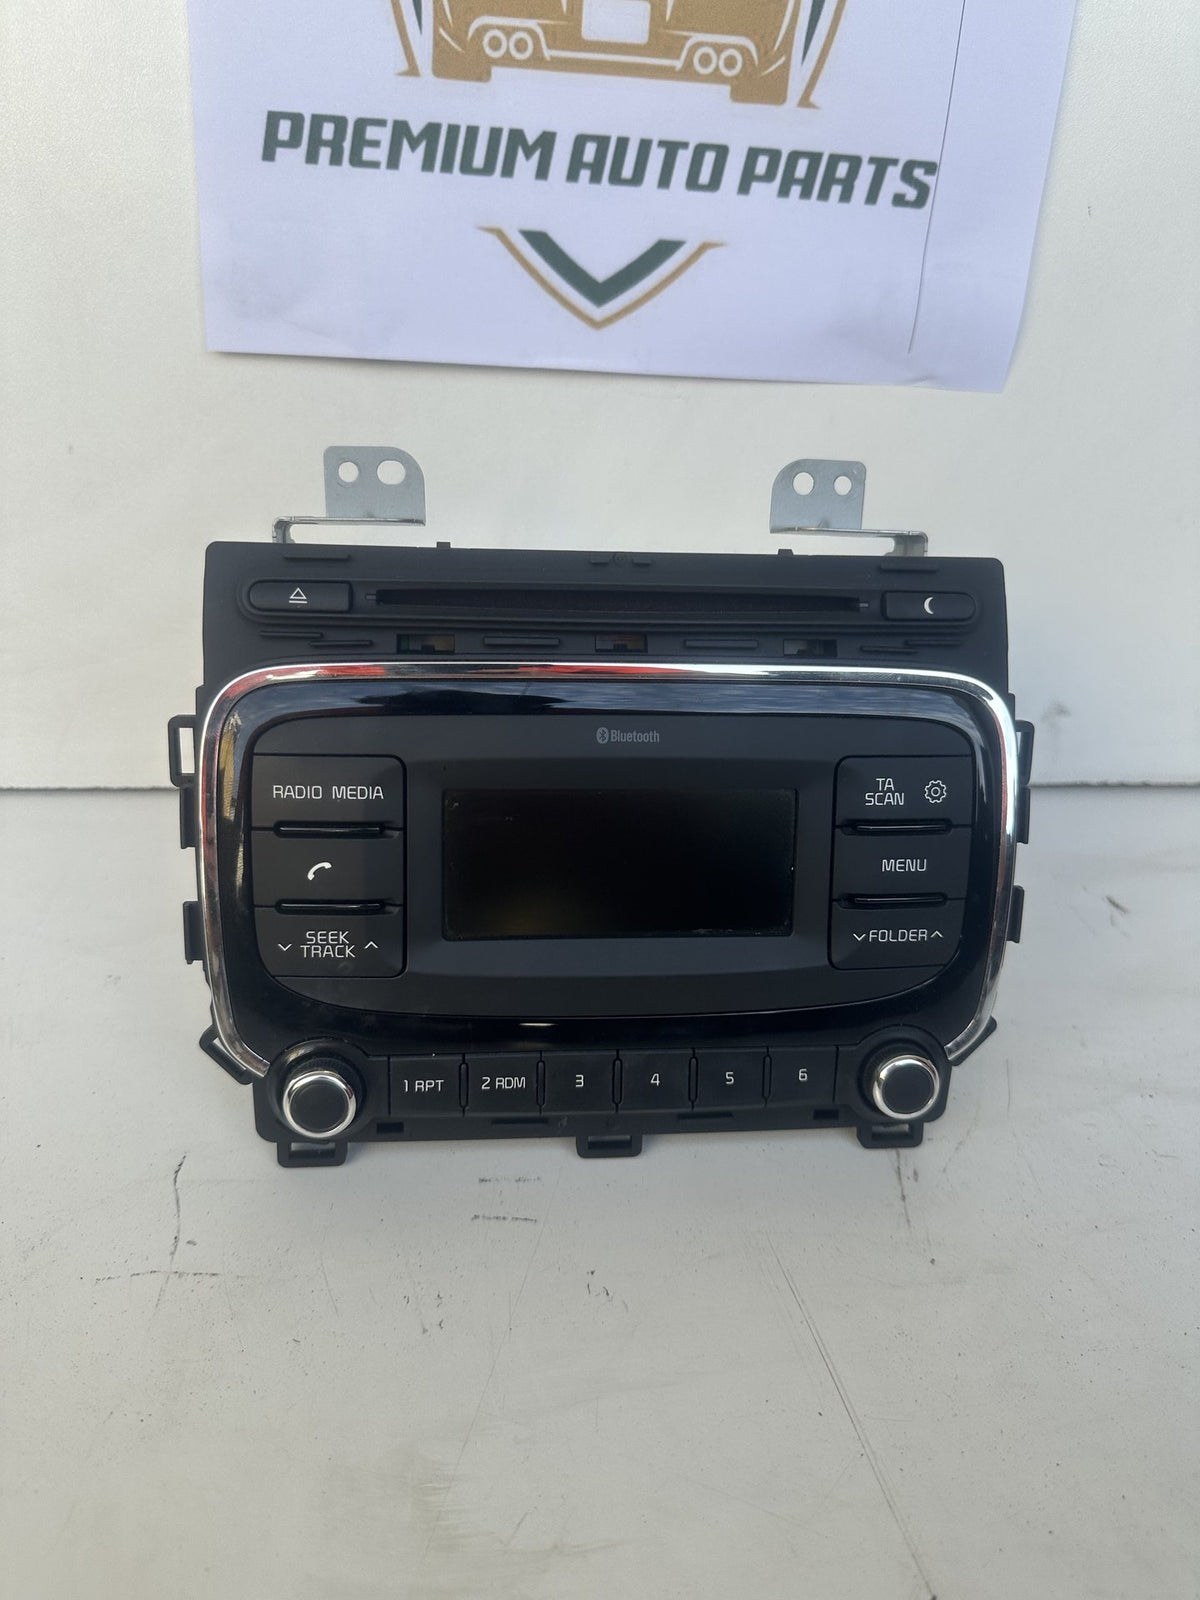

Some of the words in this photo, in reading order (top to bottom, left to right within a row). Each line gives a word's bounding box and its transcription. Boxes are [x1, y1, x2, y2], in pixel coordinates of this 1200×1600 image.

[262, 111, 557, 181] PREMIUM
[566, 134, 729, 192] AUTO
[737, 147, 937, 209] PARTS
[610, 729, 660, 743] Bluetooth
[875, 777, 895, 790] TA
[272, 784, 323, 800] RADIO
[332, 785, 384, 800] MEDIA
[865, 793, 905, 806] SCAN
[881, 858, 927, 872] MENU
[305, 930, 350, 943] SEEK
[868, 928, 928, 942] FOLDER
[299, 945, 356, 958] TRACK
[575, 1074, 584, 1088] 3
[650, 1073, 660, 1087] 4
[725, 1071, 735, 1085] 5
[798, 1068, 808, 1082] 6
[403, 1079, 409, 1093] 1
[414, 1079, 445, 1092] RPT
[481, 1076, 491, 1090] 2
[495, 1076, 526, 1090] RDM
